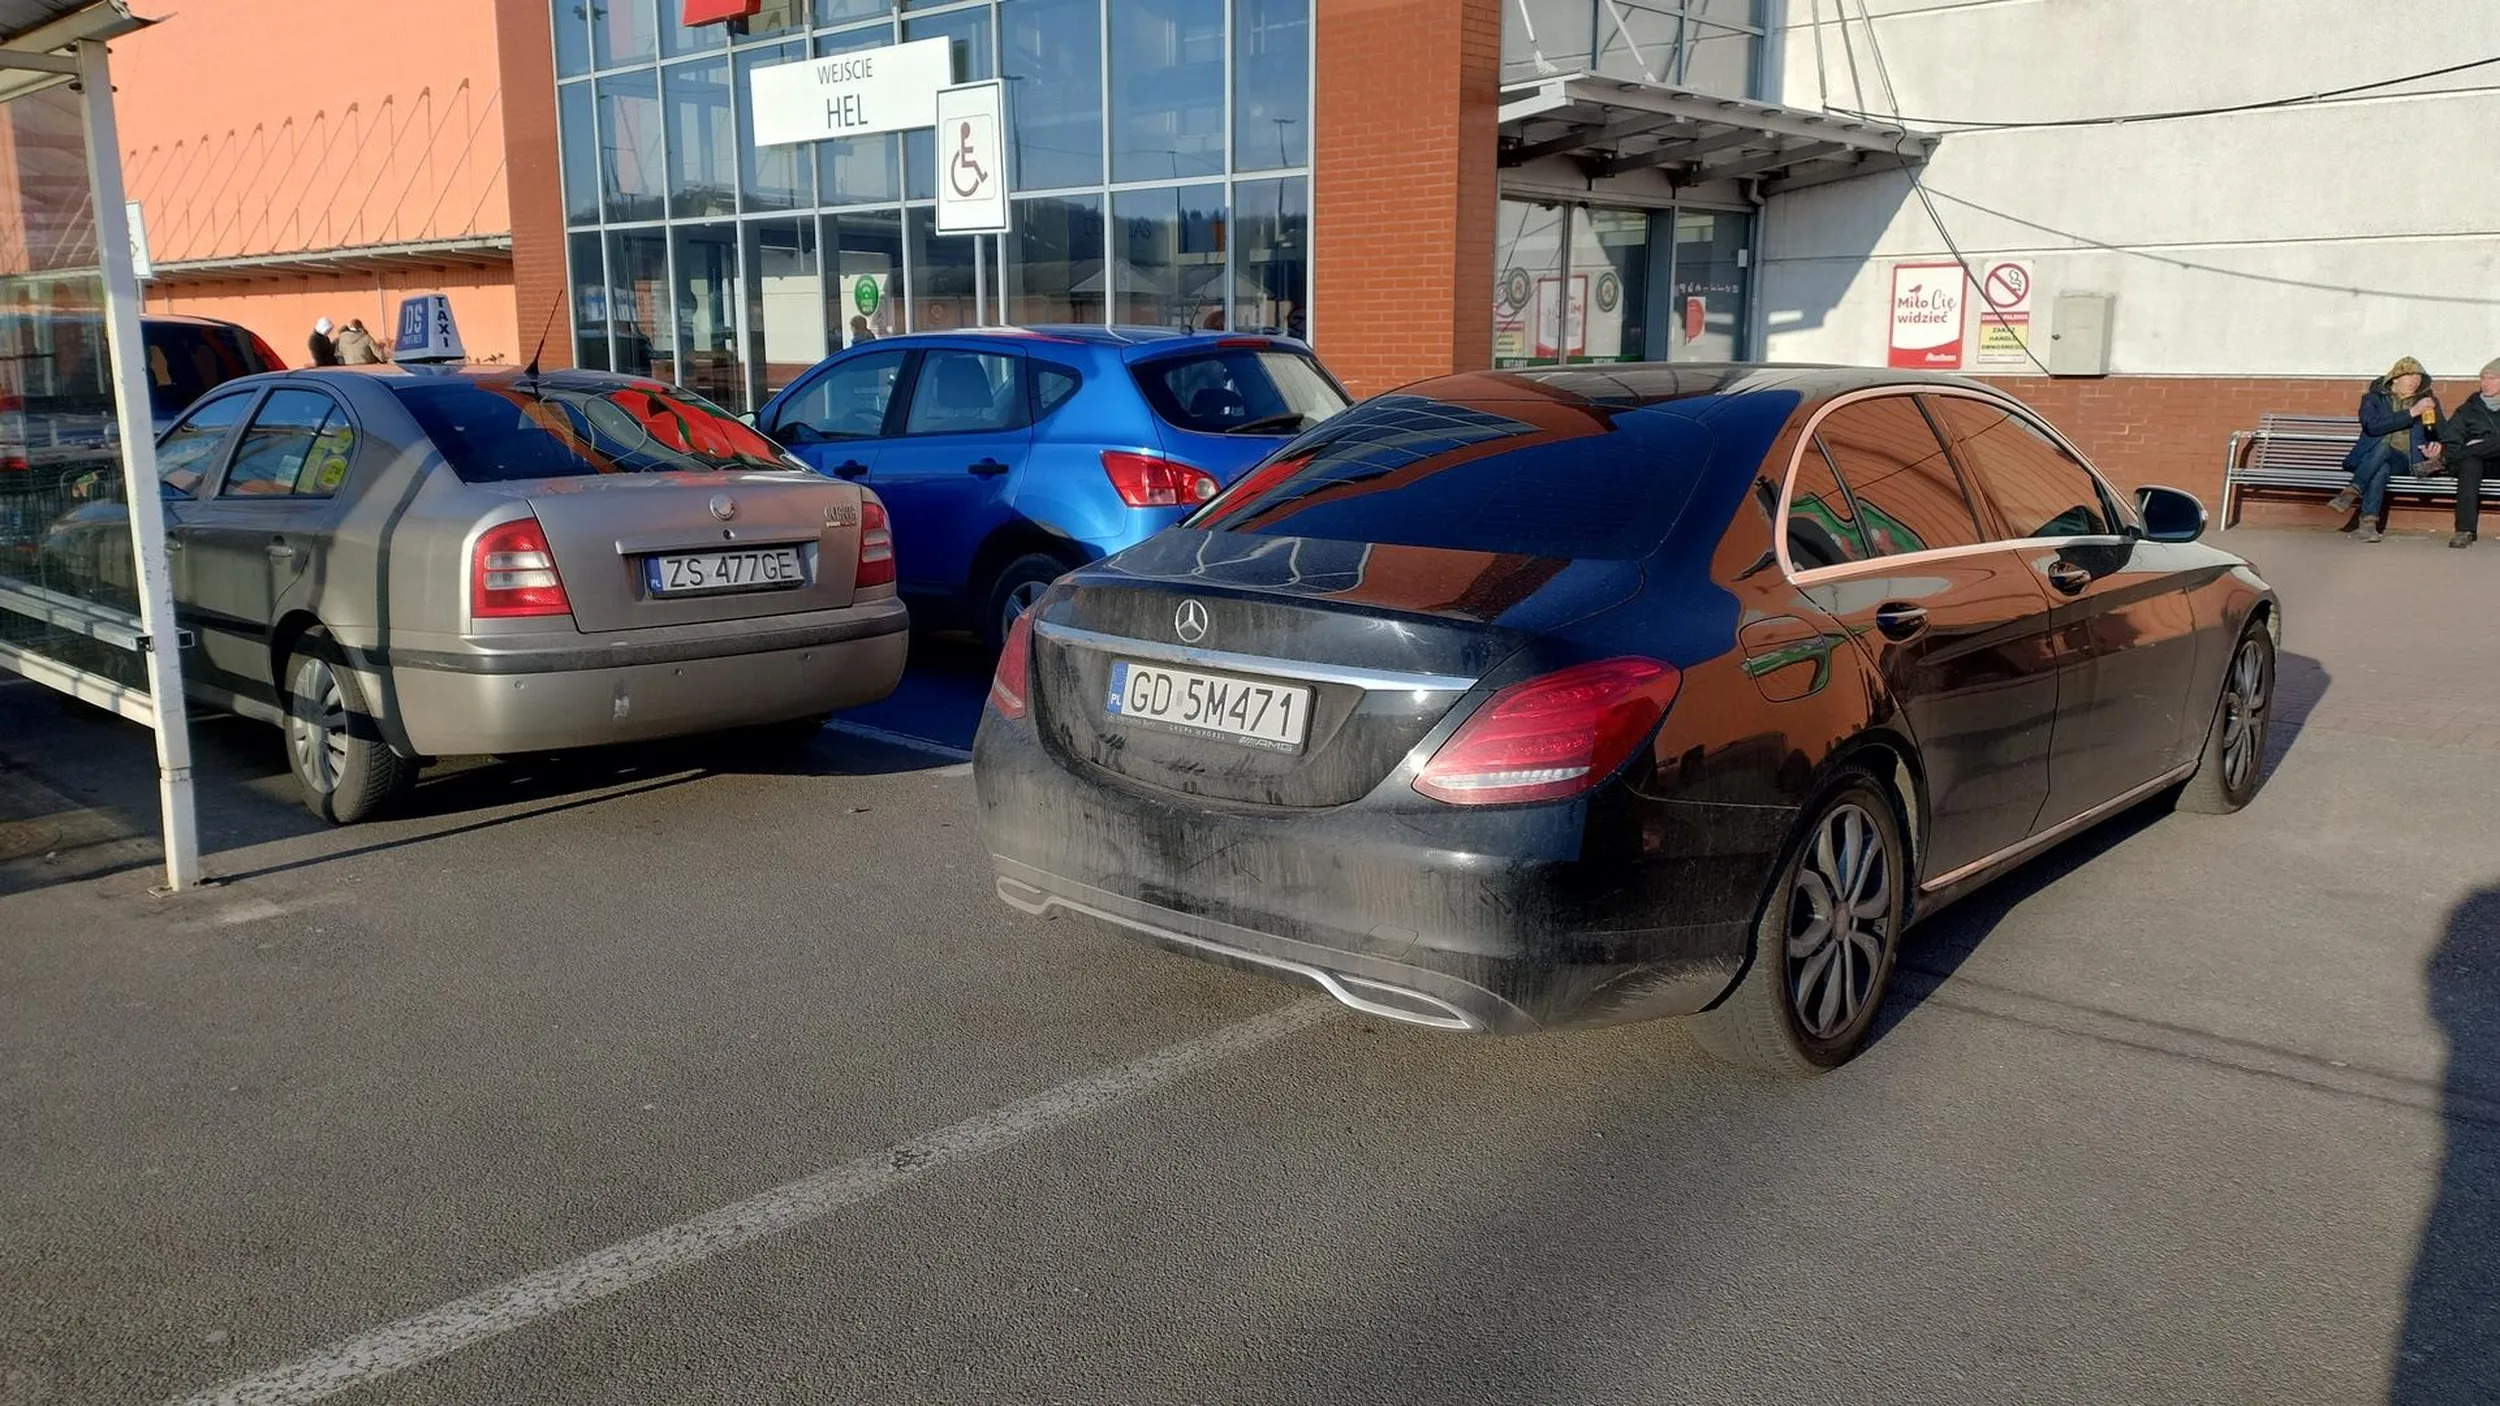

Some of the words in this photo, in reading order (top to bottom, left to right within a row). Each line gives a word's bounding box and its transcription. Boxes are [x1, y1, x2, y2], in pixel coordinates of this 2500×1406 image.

[817, 58, 873, 84] WEJŚCIE
[827, 94, 868, 129] HEL
[1897, 294, 1929, 308] Miło
[1931, 289, 1957, 312] Cię
[405, 304, 422, 335] DS
[436, 297, 450, 348] TAXI
[1898, 311, 1948, 323] widzieć
[666, 559, 703, 588] ZS
[715, 552, 792, 584] 477GE
[1110, 694, 1121, 705] PL
[1130, 671, 1173, 716] GD
[1183, 679, 1292, 737] 5M471
[1254, 740, 1293, 753] AMG
